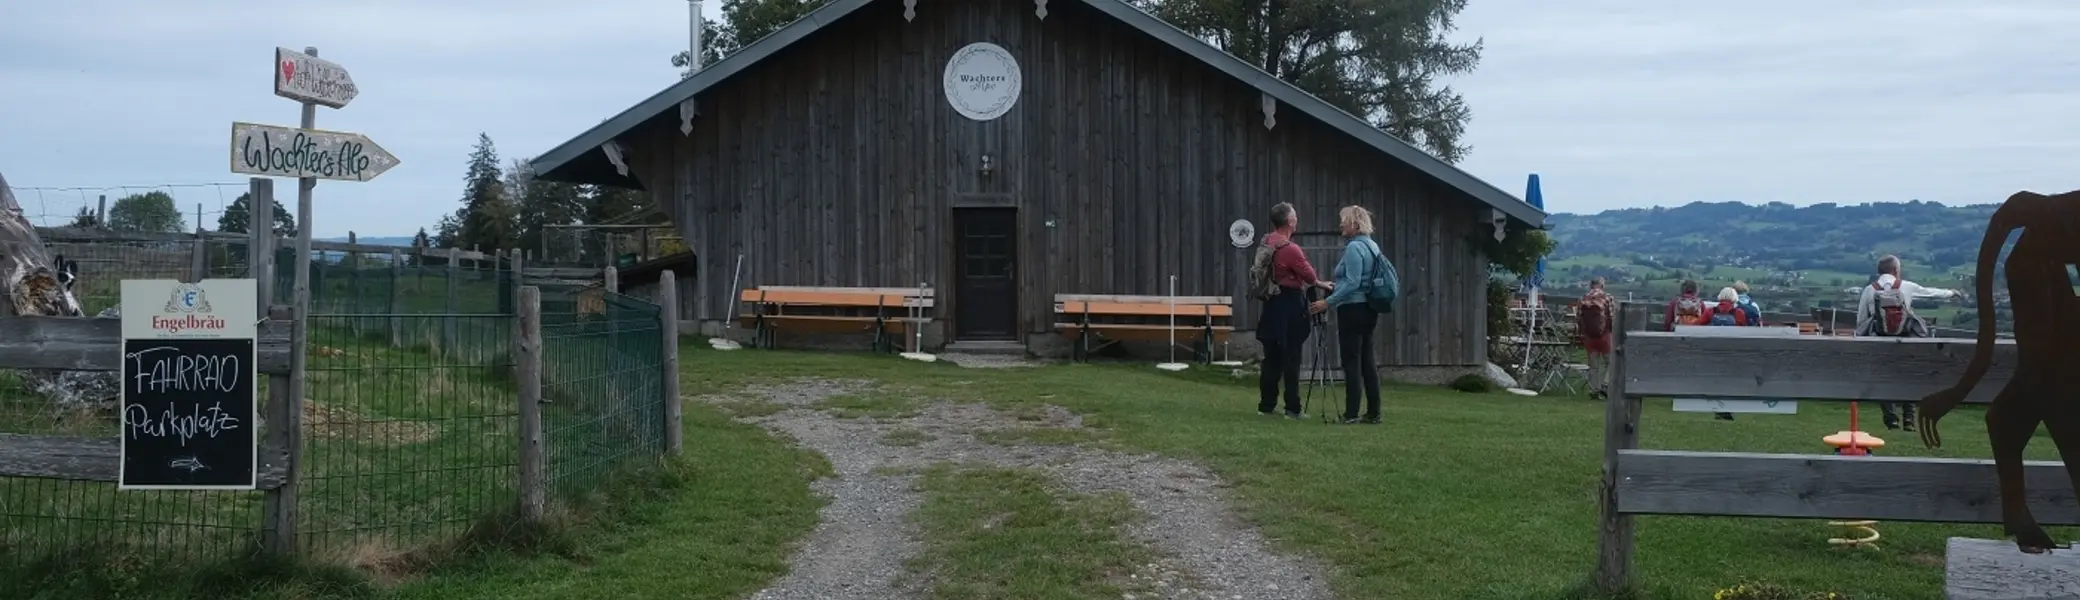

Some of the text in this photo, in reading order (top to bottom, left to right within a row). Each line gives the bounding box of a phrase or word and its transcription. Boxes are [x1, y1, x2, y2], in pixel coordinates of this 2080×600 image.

[244, 131, 370, 181] Wachters Alp
[152, 315, 225, 333] Engelbräu
[124, 401, 240, 447] Parkplatz
